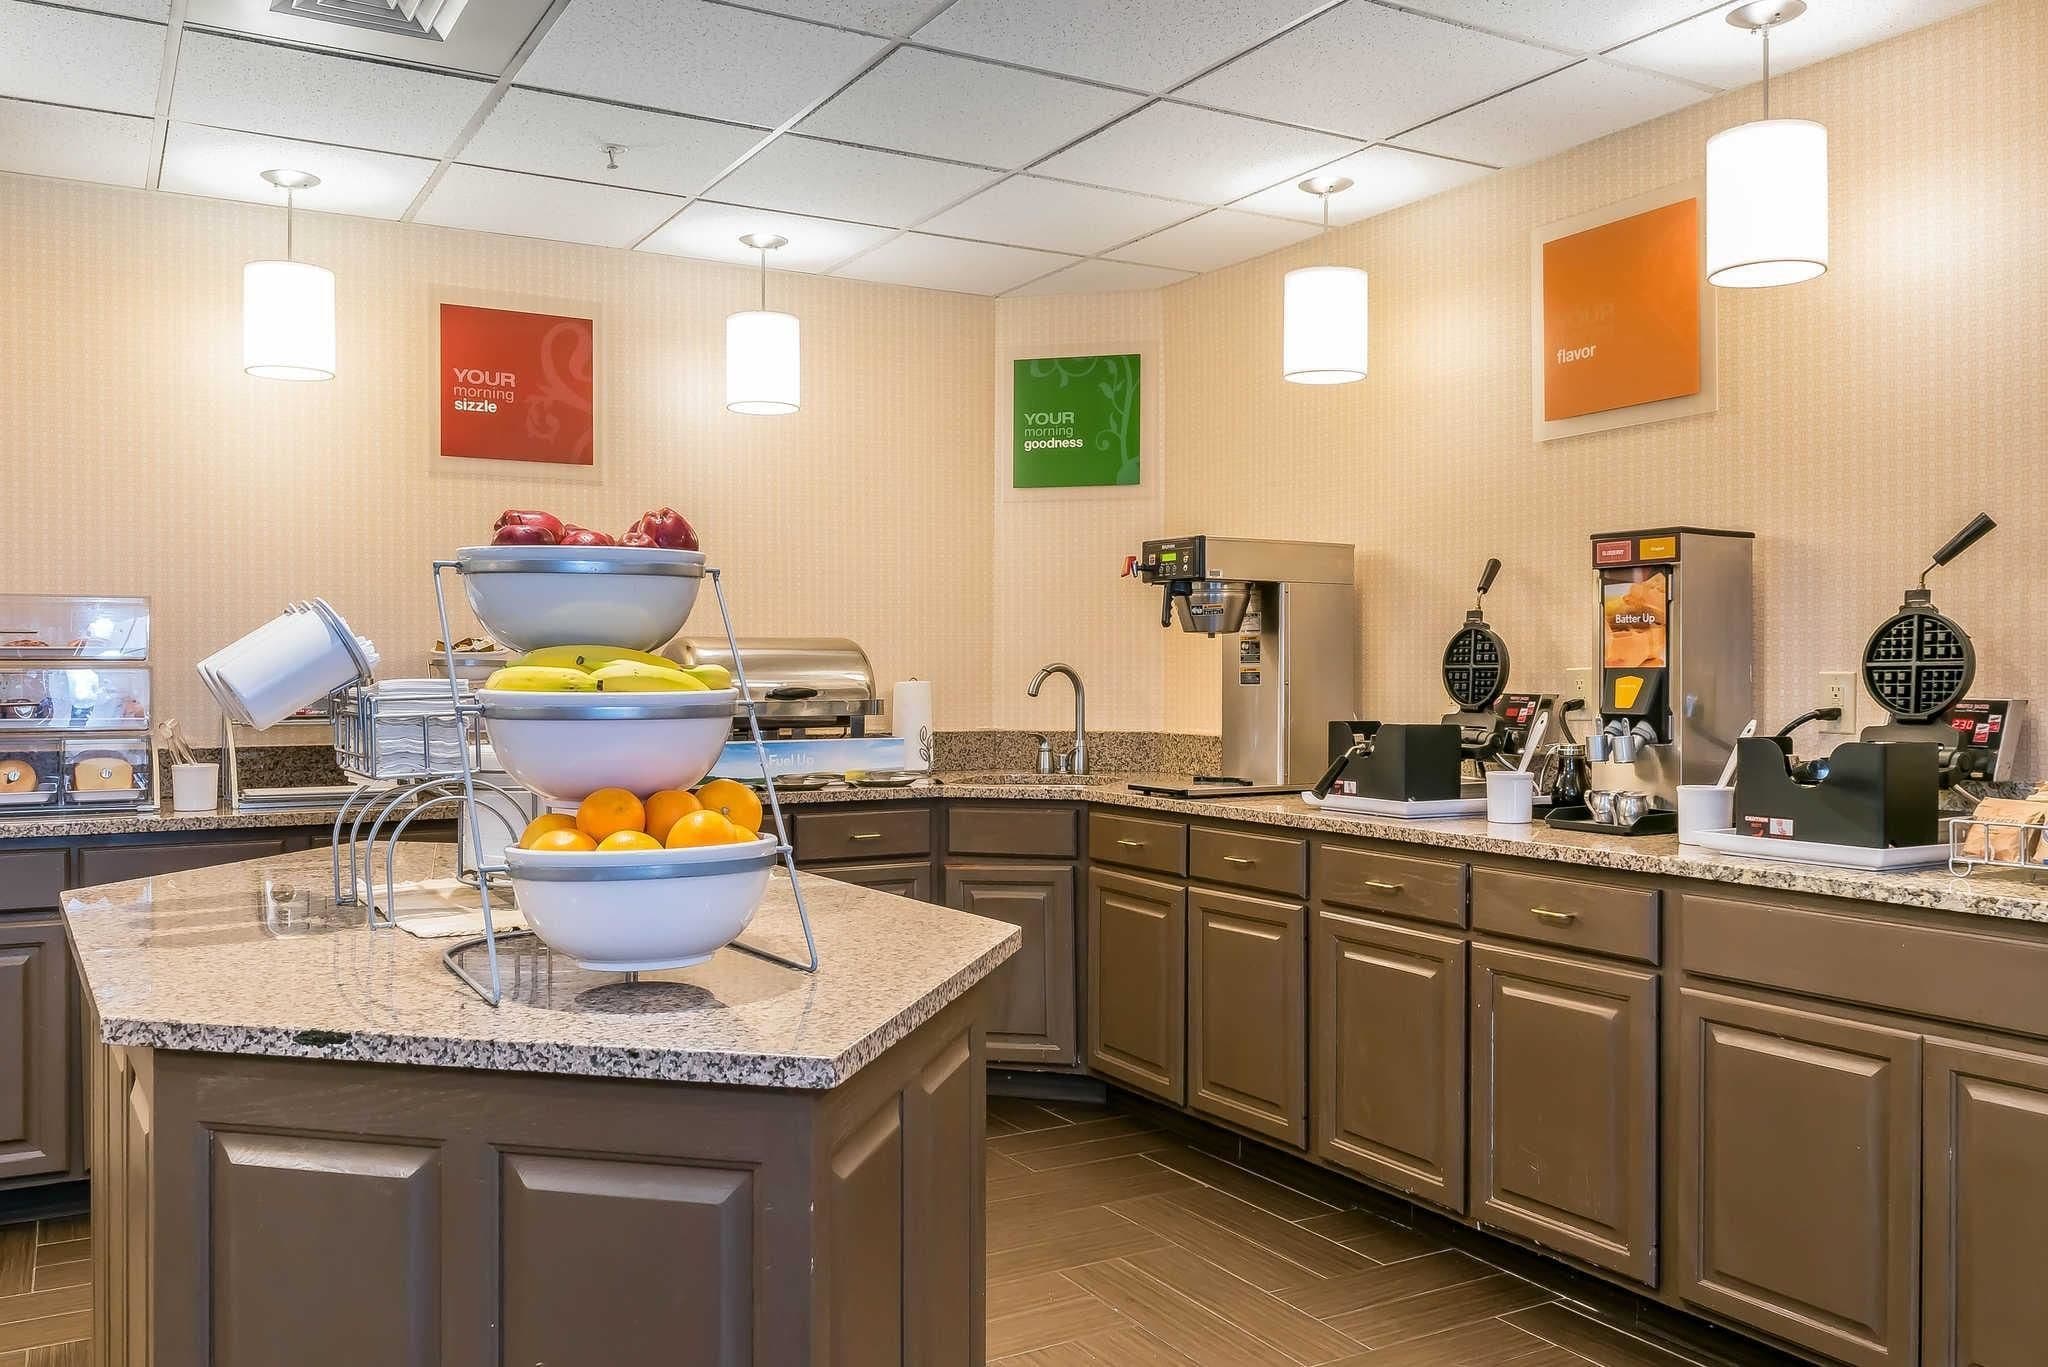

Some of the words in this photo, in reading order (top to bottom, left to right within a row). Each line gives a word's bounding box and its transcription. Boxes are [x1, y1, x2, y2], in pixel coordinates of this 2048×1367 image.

[1557, 345, 1597, 364] flavor
[453, 367, 516, 387] YOUR
[453, 385, 515, 403] morning
[454, 398, 498, 413] sizzle
[1024, 411, 1075, 425] YOUR
[1024, 426, 1074, 438] morning
[1024, 437, 1084, 451] goodness
[1615, 614, 1641, 624] Batter
[1642, 612, 1656, 625] Up
[1951, 719, 1975, 730] 230
[768, 753, 794, 767] Fuel
